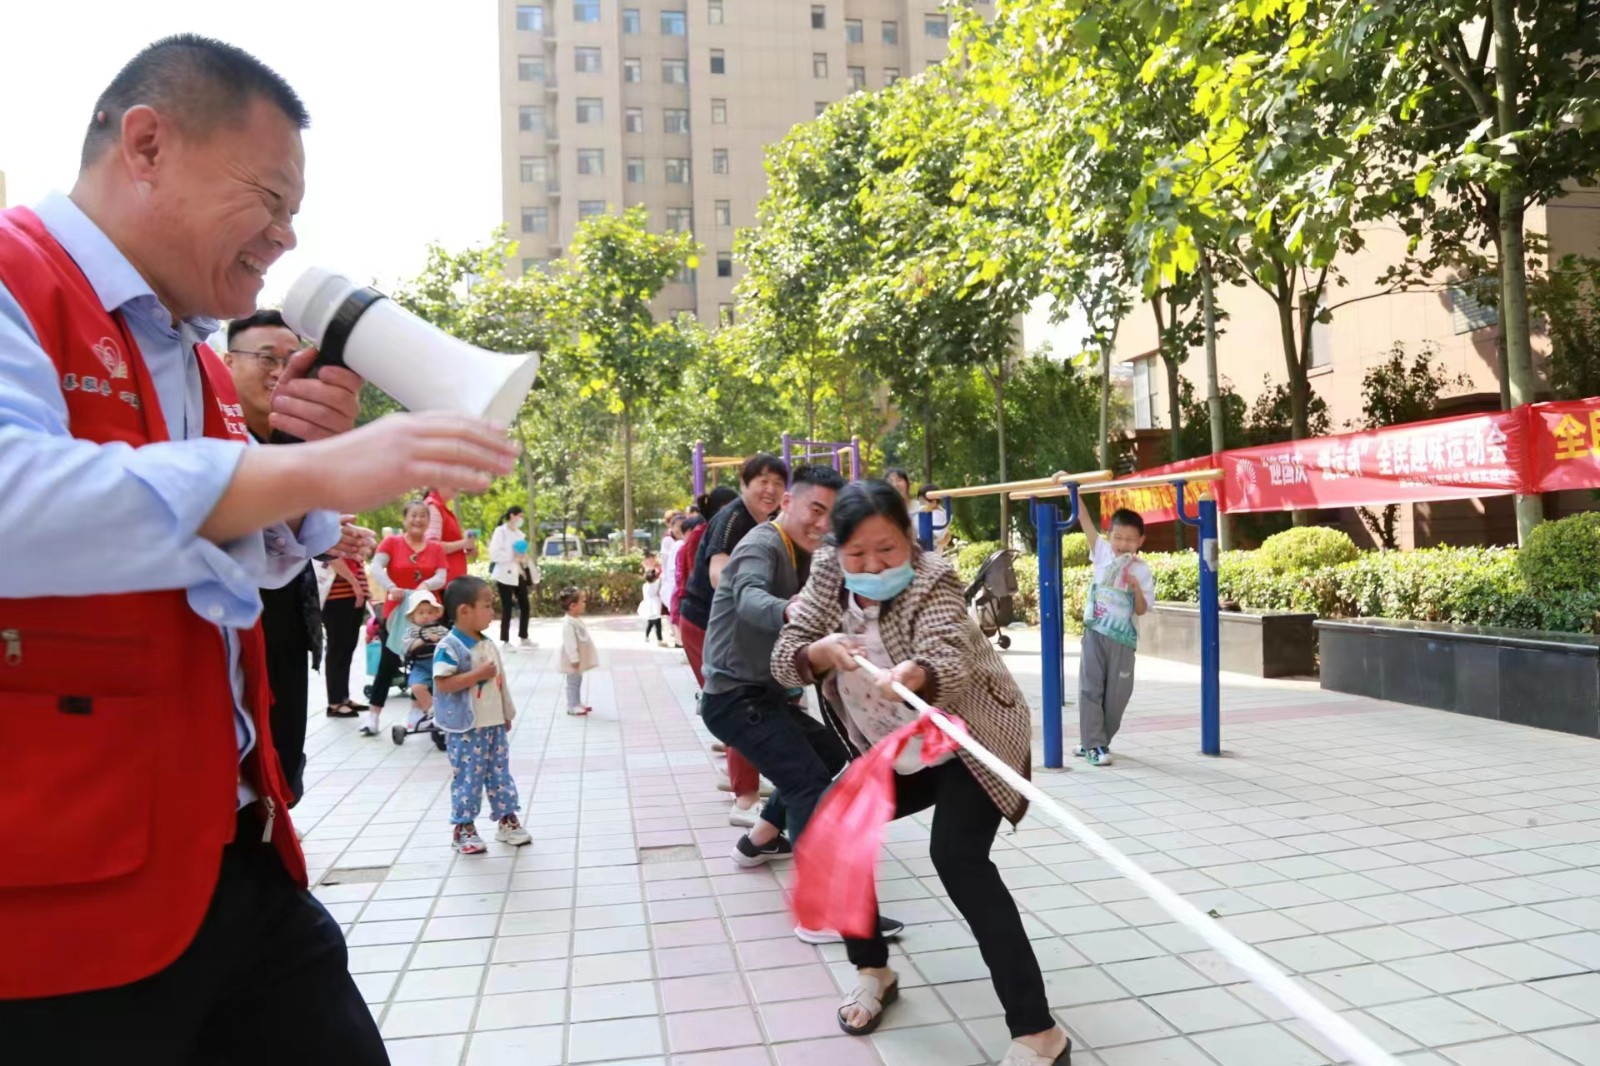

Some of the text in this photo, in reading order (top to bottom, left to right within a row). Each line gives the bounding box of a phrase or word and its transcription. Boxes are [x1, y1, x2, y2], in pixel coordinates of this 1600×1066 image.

[1376, 421, 1508, 475] 全民趣味运动会
